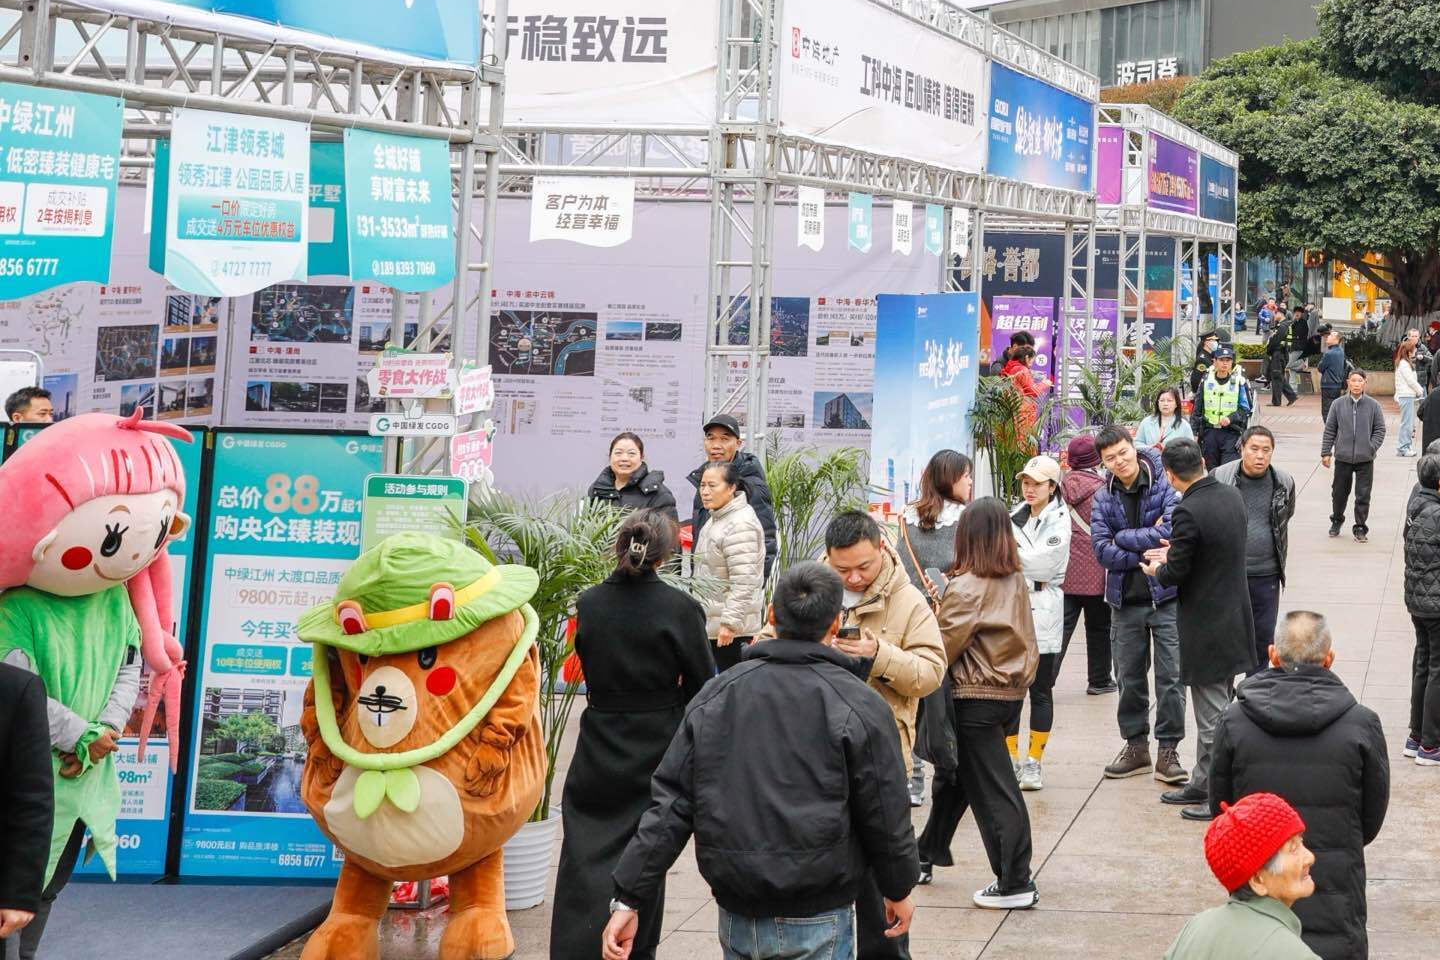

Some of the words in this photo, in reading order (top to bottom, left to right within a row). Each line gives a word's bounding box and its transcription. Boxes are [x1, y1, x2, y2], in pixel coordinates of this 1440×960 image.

[1116, 57, 1178, 86] 波司登
[207, 124, 285, 159] 江津领秀城
[545, 194, 610, 211] 客户为本
[555, 213, 621, 231] 经营幸福
[27, 257, 59, 276] 6777
[378, 368, 447, 386] 零食大作战
[392, 420, 424, 431] 中国绿发
[425, 421, 450, 431] CGDG
[384, 482, 449, 496] 活动参与规则
[224, 567, 274, 583] 中绿江州
[239, 588, 309, 606] 9800元起
[241, 619, 298, 638] 今年买
